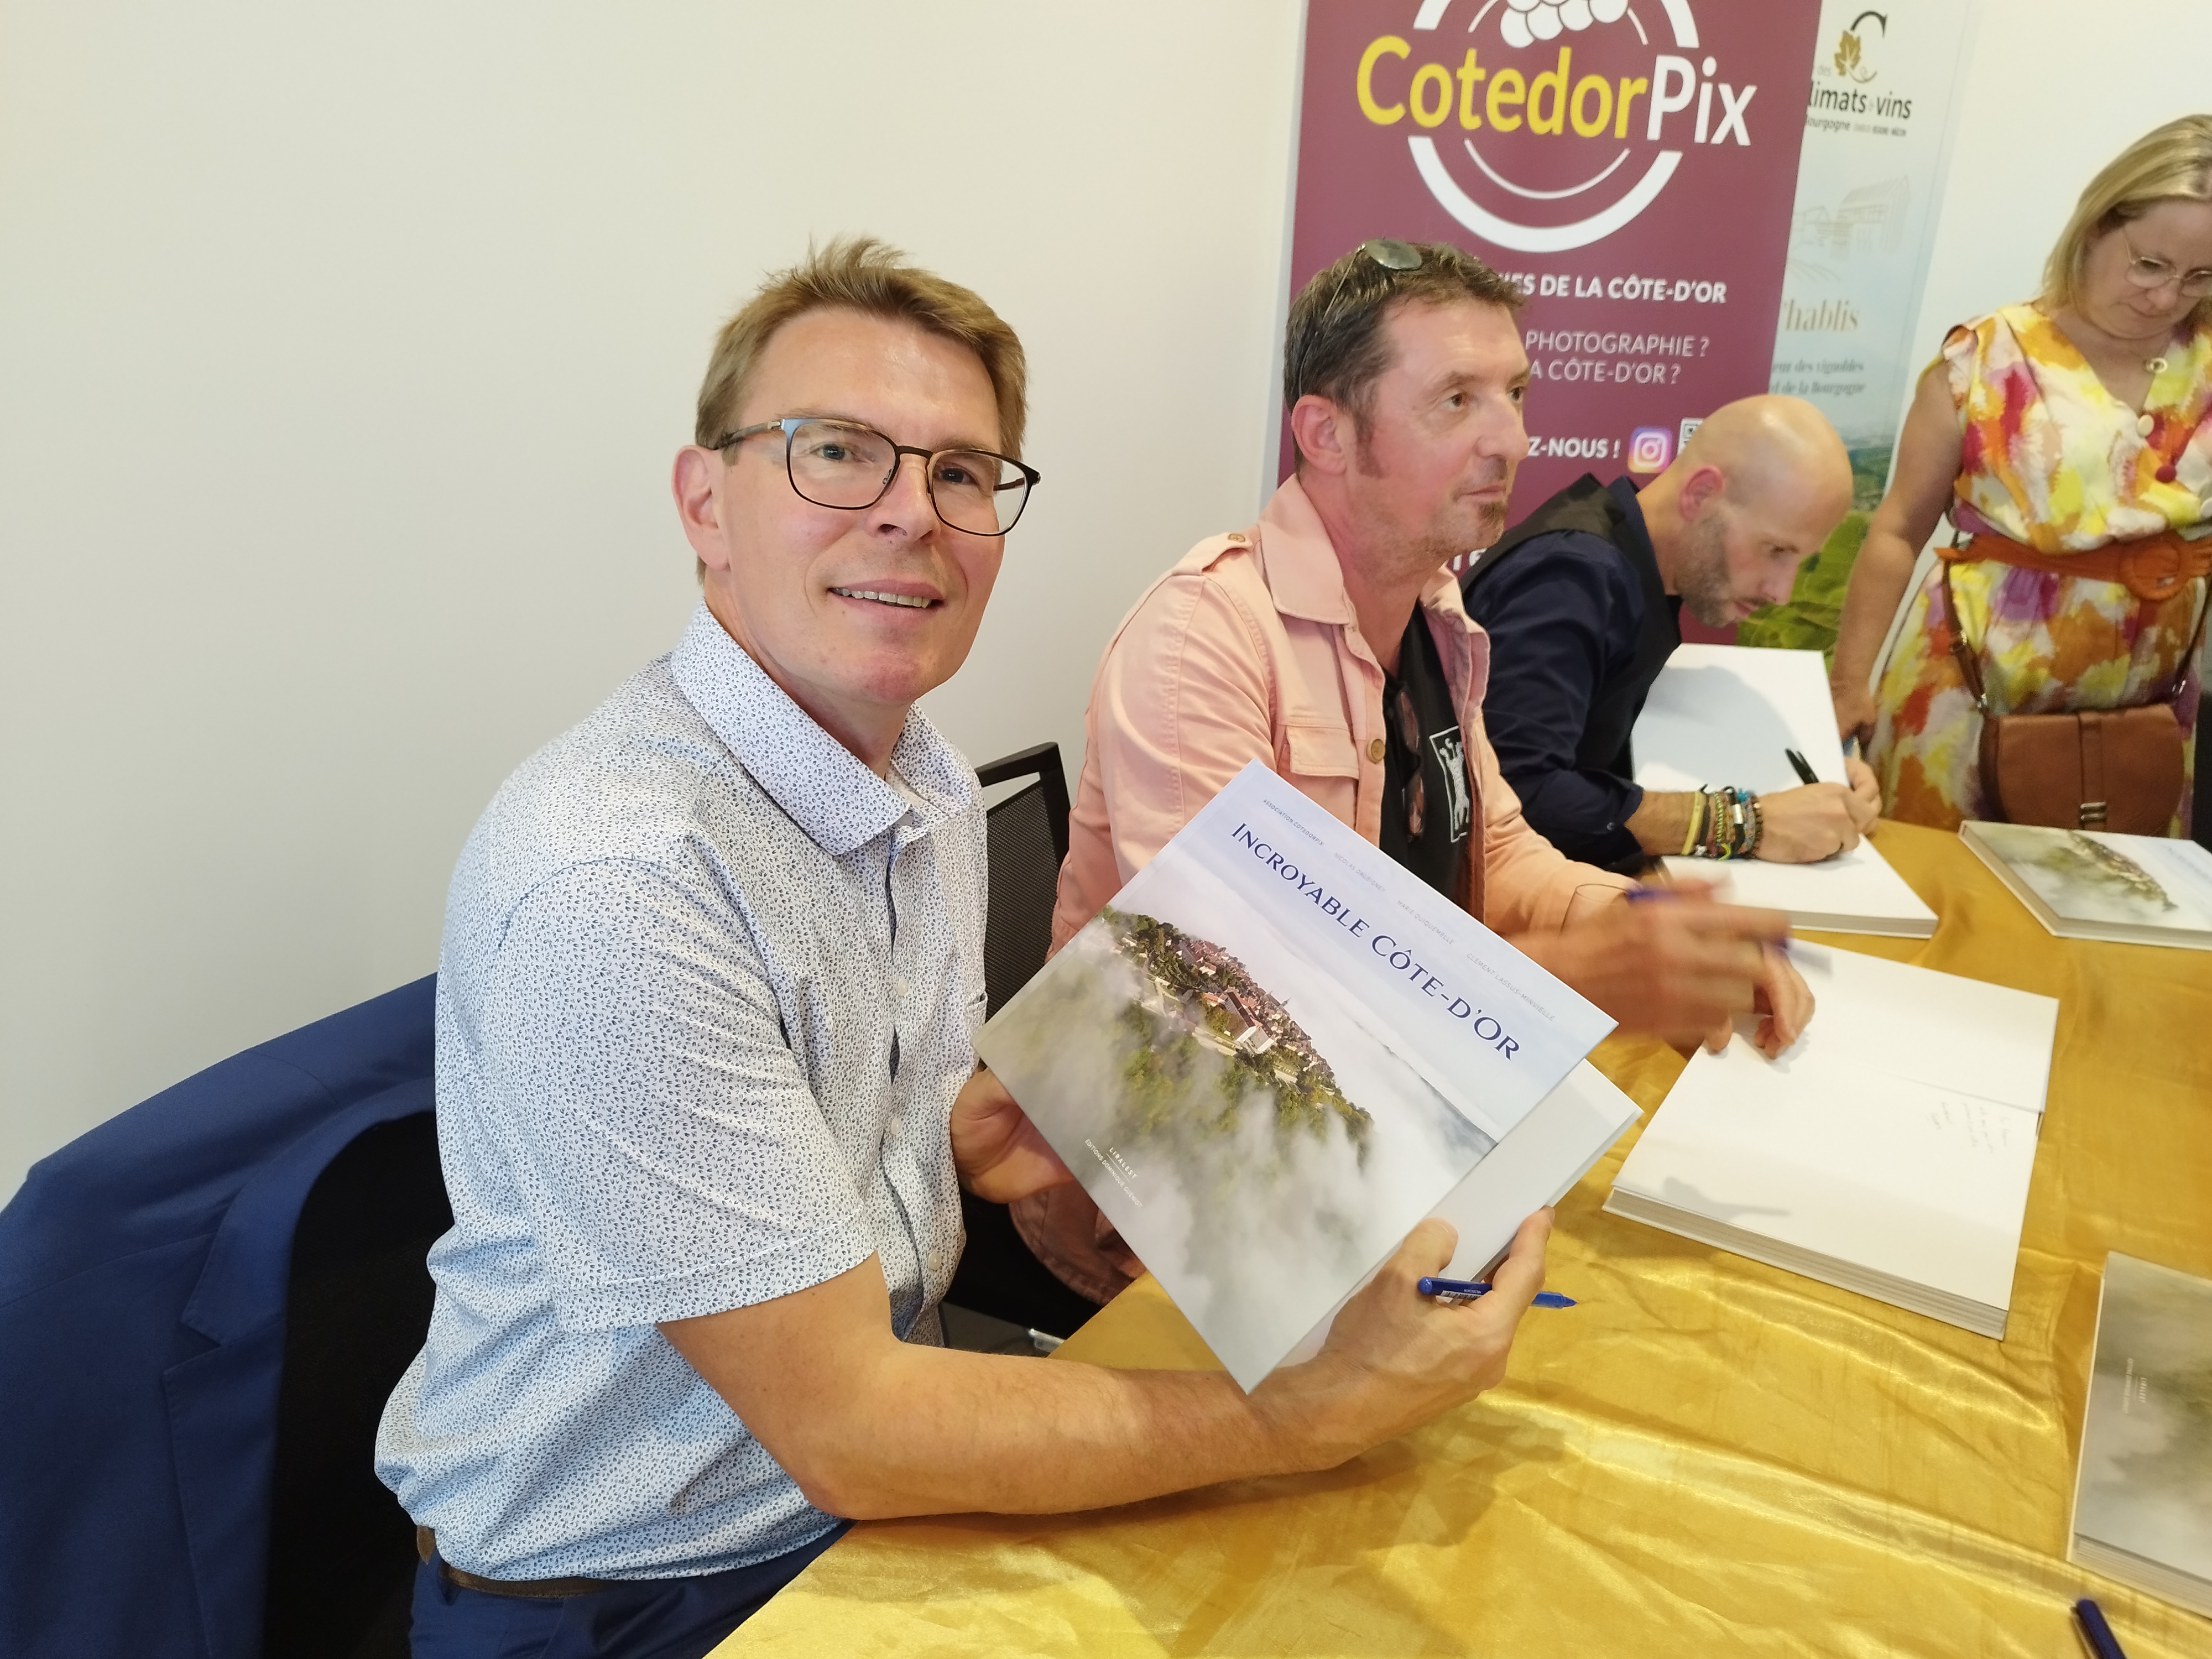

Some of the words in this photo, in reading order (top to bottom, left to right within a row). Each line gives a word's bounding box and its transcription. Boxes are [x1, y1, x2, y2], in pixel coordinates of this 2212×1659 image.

[1357, 35, 1757, 147] CotedorPix
[1877, 90, 1912, 119] vins
[1539, 273, 1571, 297] DE
[1574, 275, 1603, 298] LA
[1608, 273, 1727, 304] CÔTE-D'OR
[1783, 299, 1860, 331] hablis
[1525, 330, 1696, 357] PHOTOGRAPHIE
[1548, 357, 1667, 384] CÔTE-D'OR
[1263, 799, 1293, 823] ASSOCIATION
[1293, 822, 1324, 847] COTEDORPIX
[1334, 852, 1357, 871] NICOLAS
[1397, 900, 1415, 915] MARIE
[1414, 914, 1455, 945] QUIQUEMELLE
[1231, 823, 1370, 938] INCROYABLE
[1371, 935, 1520, 1061] CÔTE-D'OR
[1495, 974, 1555, 1021] LASSUS-MINVIELLE
[1109, 1146, 1137, 1179] LIRALEST
